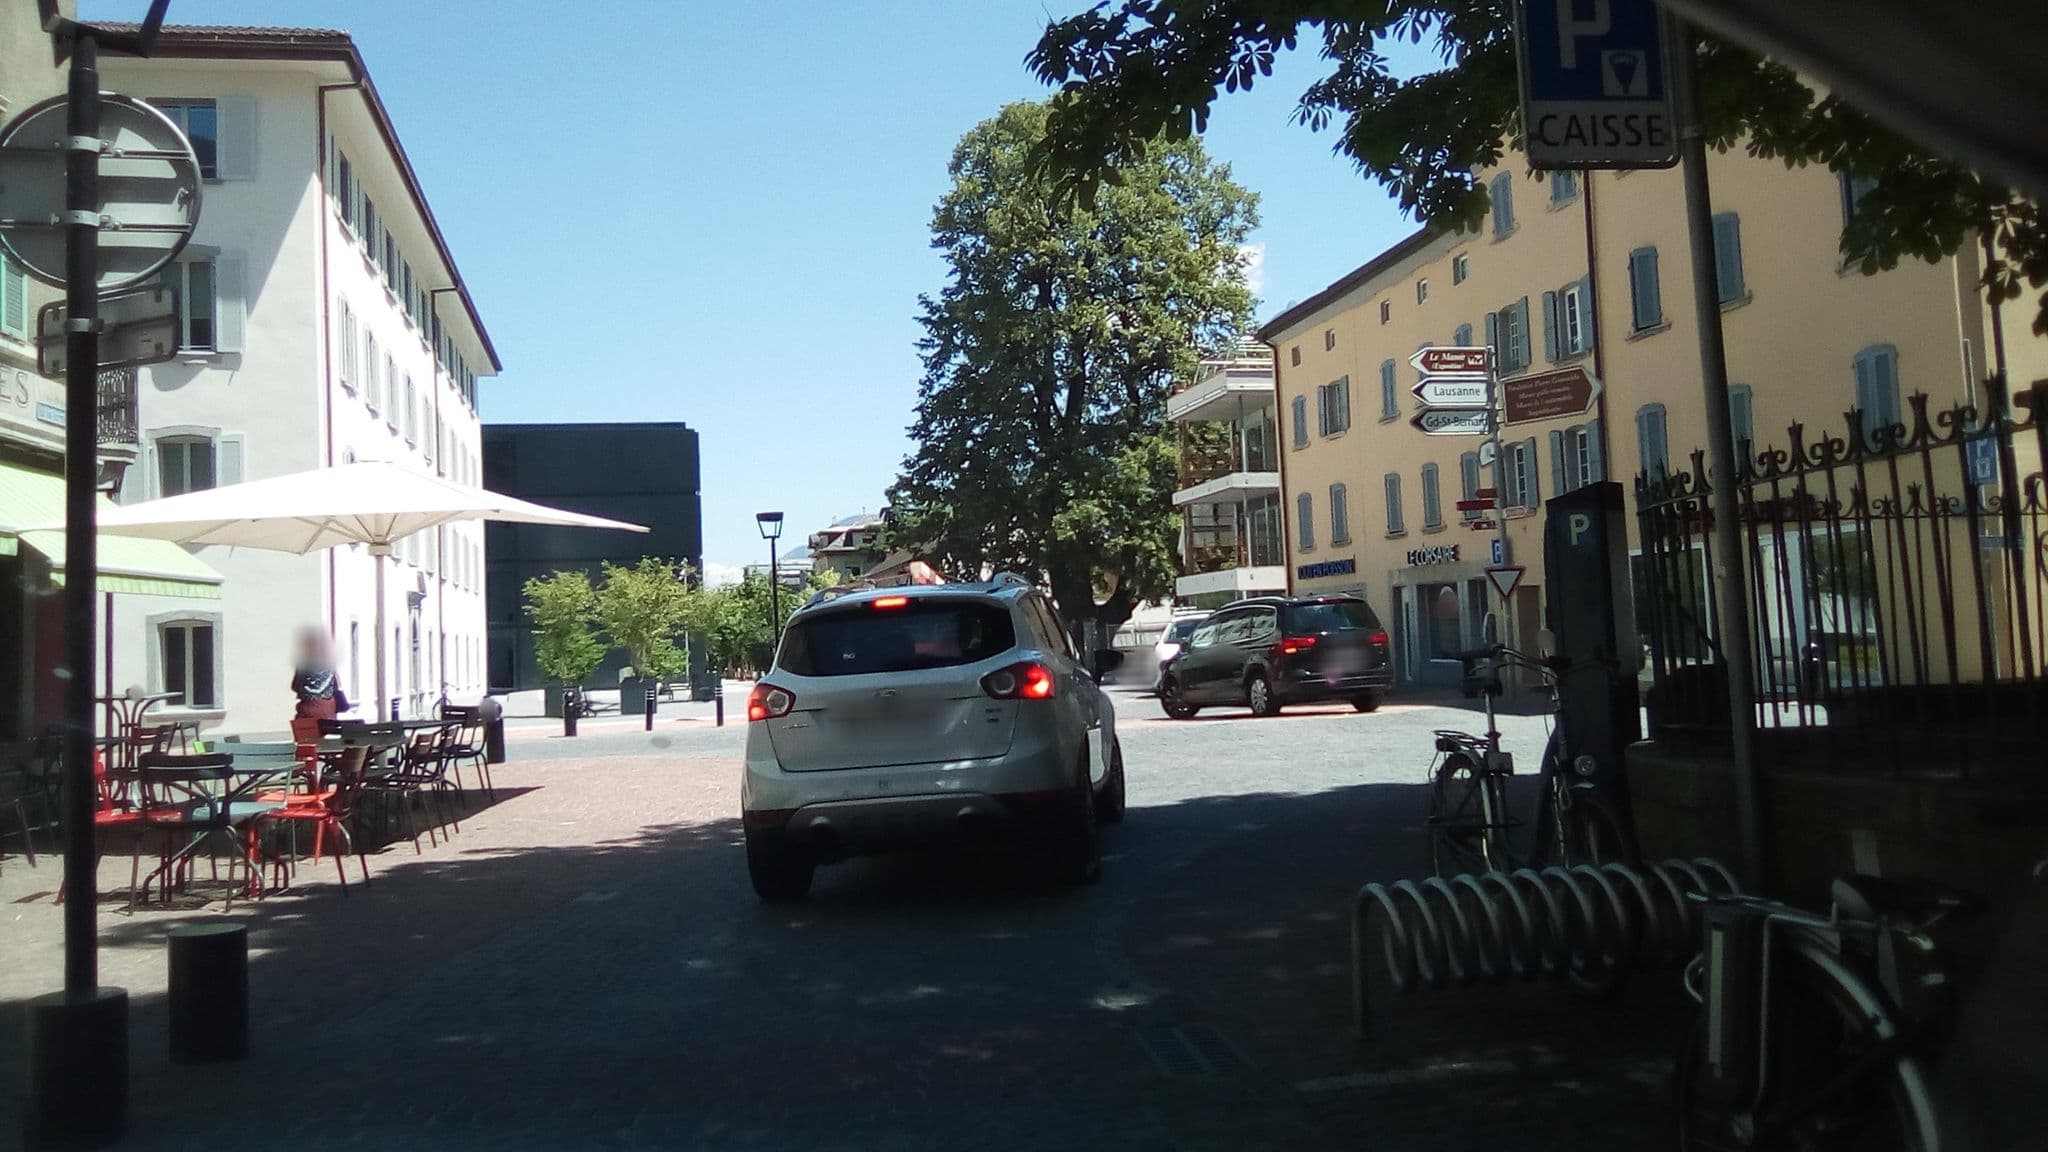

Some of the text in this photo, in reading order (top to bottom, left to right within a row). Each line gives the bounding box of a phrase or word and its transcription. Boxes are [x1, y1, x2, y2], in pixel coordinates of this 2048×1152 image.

[1556, 0, 1612, 69] P
[1538, 114, 1665, 147] CAISSE
[1434, 386, 1481, 397] Lausanne
[1569, 513, 1590, 545] P
